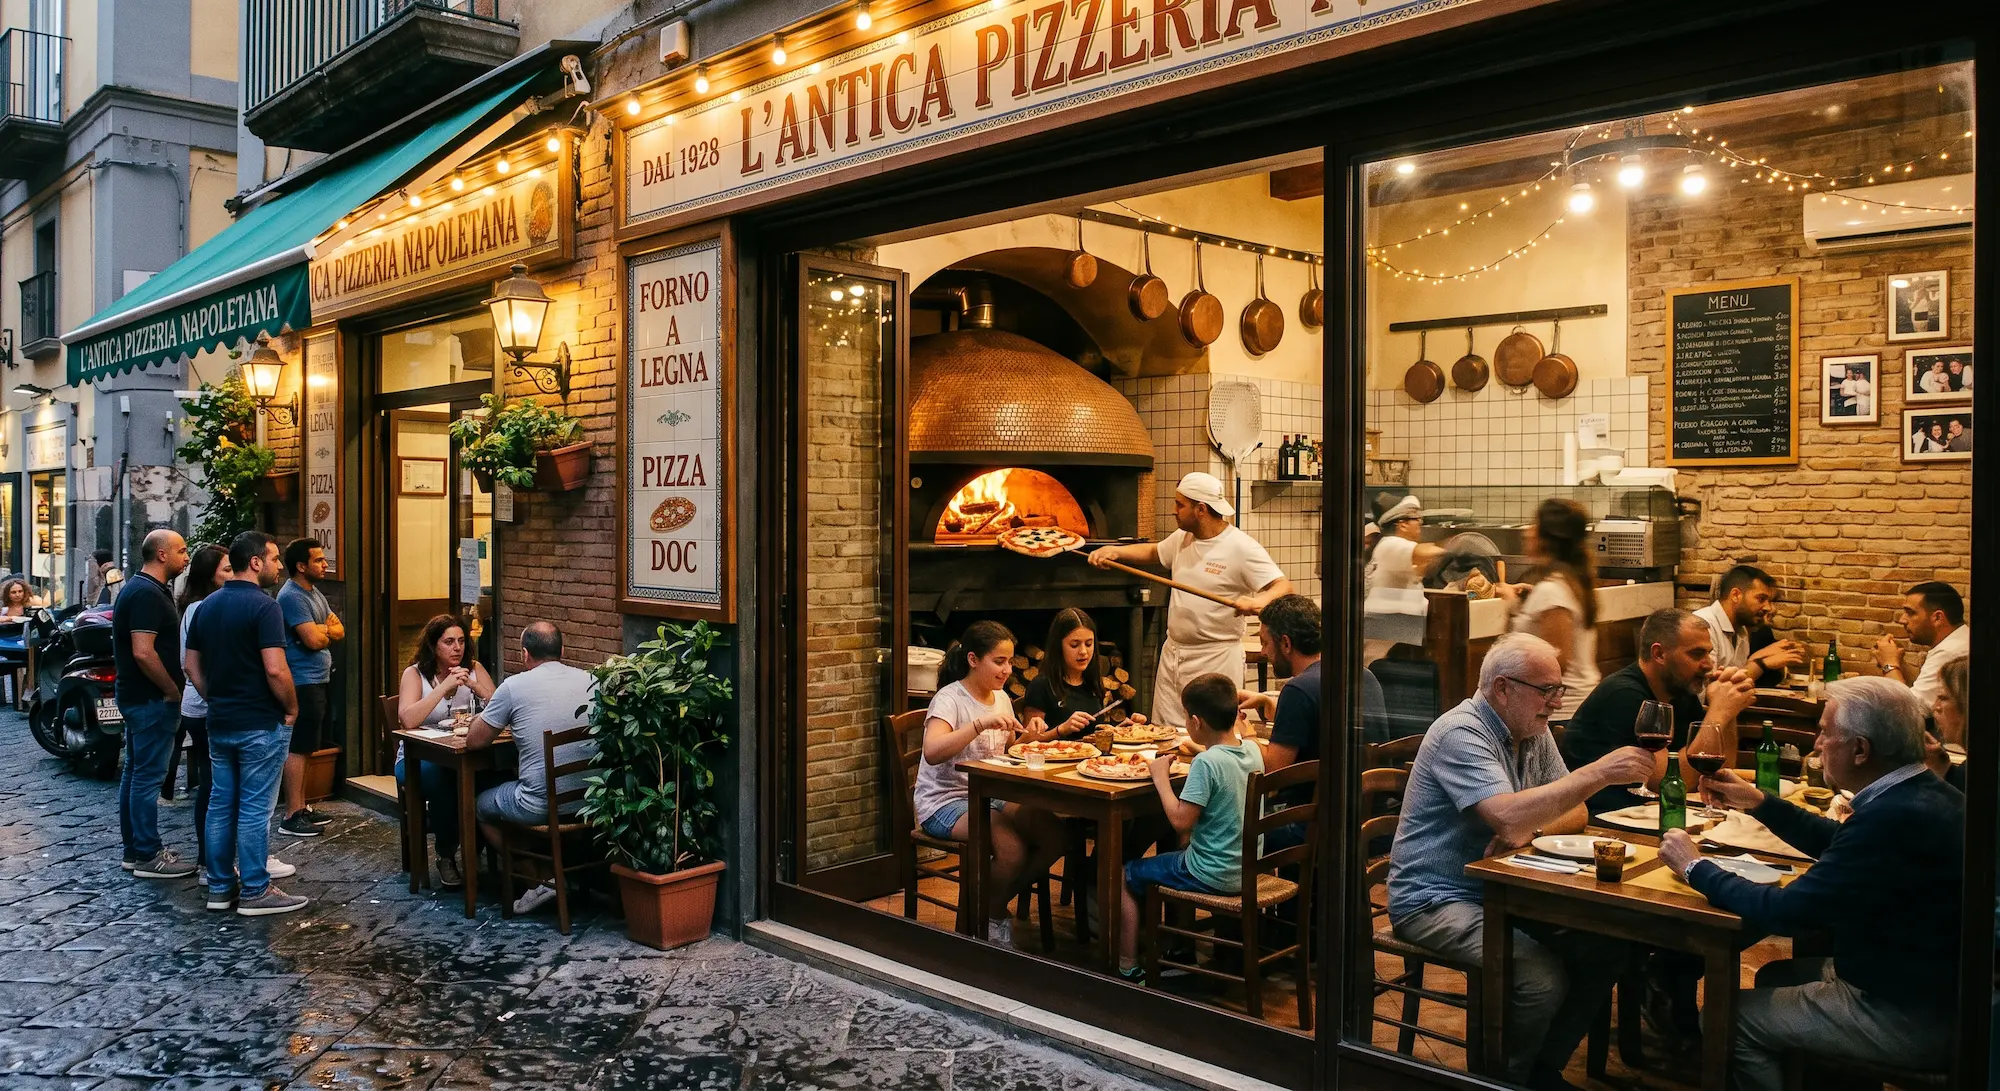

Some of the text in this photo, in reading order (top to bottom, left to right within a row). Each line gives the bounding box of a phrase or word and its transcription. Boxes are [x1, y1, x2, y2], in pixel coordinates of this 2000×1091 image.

[740, 43, 955, 178] L'ANTICA
[643, 137, 720, 187] DAL 1928
[335, 239, 399, 295] PIZZERIA
[403, 195, 520, 277] NAPOLETANA
[640, 271, 709, 313] FORNO
[1708, 293, 1749, 310] MENU
[80, 284, 279, 373] L'ANTICA PIZZERIA NAPOLETANA
[666, 315, 681, 346] A
[640, 351, 709, 388] LEGNA
[310, 411, 334, 433] LEGNA
[311, 473, 334, 495] PIZZA
[642, 453, 707, 488] PIZZA
[651, 540, 697, 574] DOC
